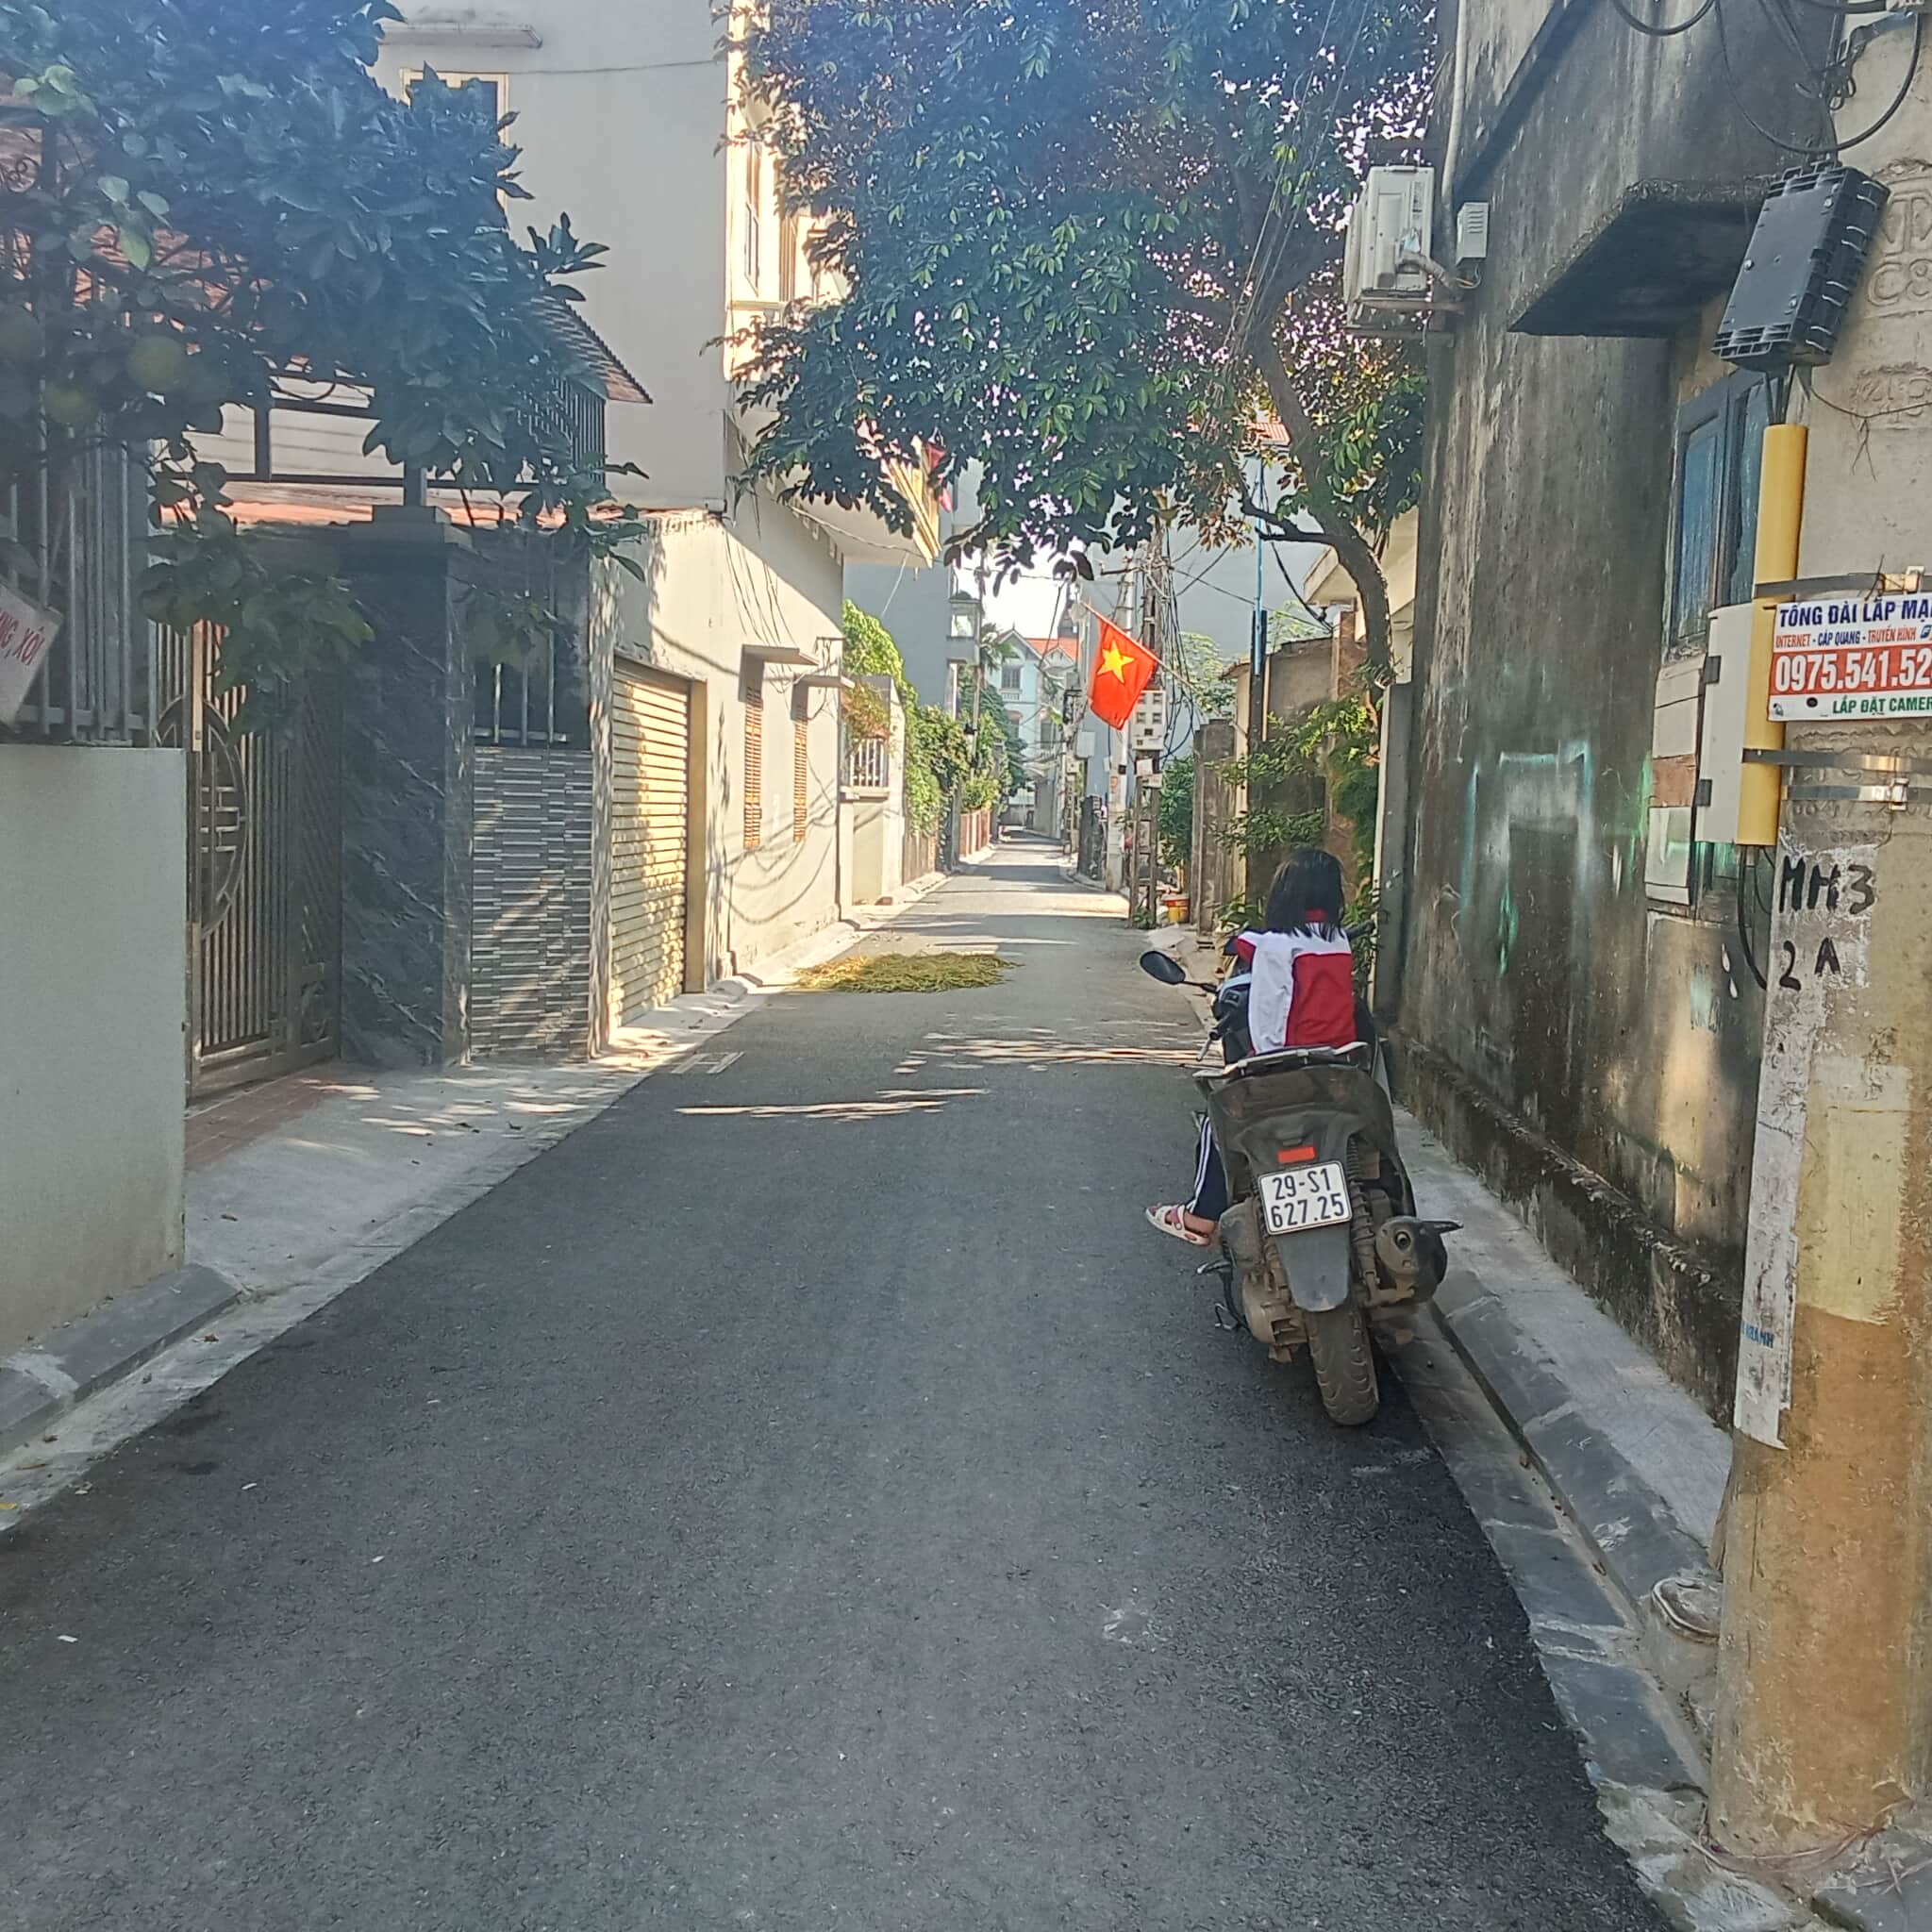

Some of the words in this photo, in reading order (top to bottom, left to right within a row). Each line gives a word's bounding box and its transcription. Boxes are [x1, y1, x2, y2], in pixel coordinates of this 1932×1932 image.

[1901, 599, 1932, 623] MẠ
[1775, 633, 1811, 649] INTERNET
[1818, 629, 1833, 646] CÁP
[1835, 630, 1860, 647] QUANG
[1774, 648, 1932, 692] 0975.541.52
[1272, 1168, 1331, 1201] 29-S1
[1271, 1192, 1345, 1228] 627.25
